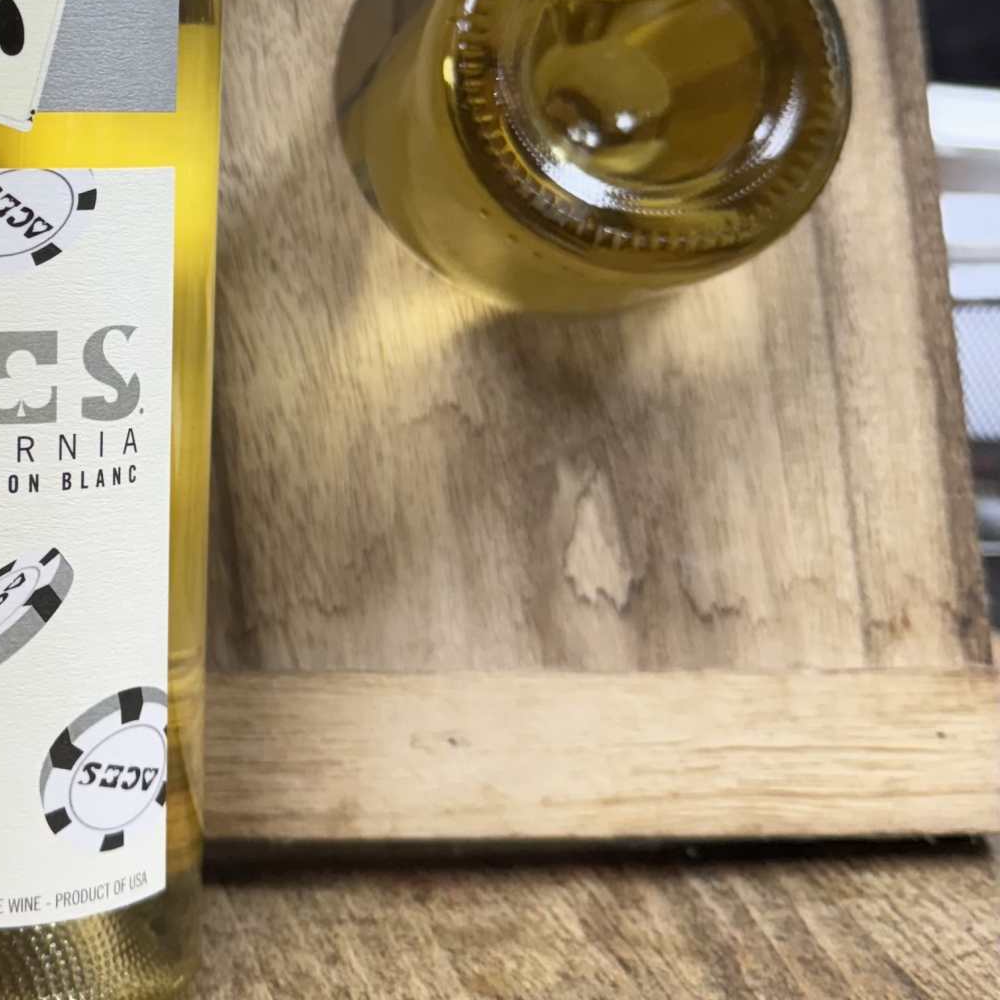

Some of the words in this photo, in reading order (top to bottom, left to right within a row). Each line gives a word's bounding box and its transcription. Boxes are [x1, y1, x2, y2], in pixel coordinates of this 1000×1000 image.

[61, 464, 138, 492] BLANC
[77, 761, 160, 792] ACES
[8, 895, 42, 913] WINE
[55, 882, 110, 908] PRODUCT
[113, 876, 127, 896] OF
[129, 871, 148, 890] USA
